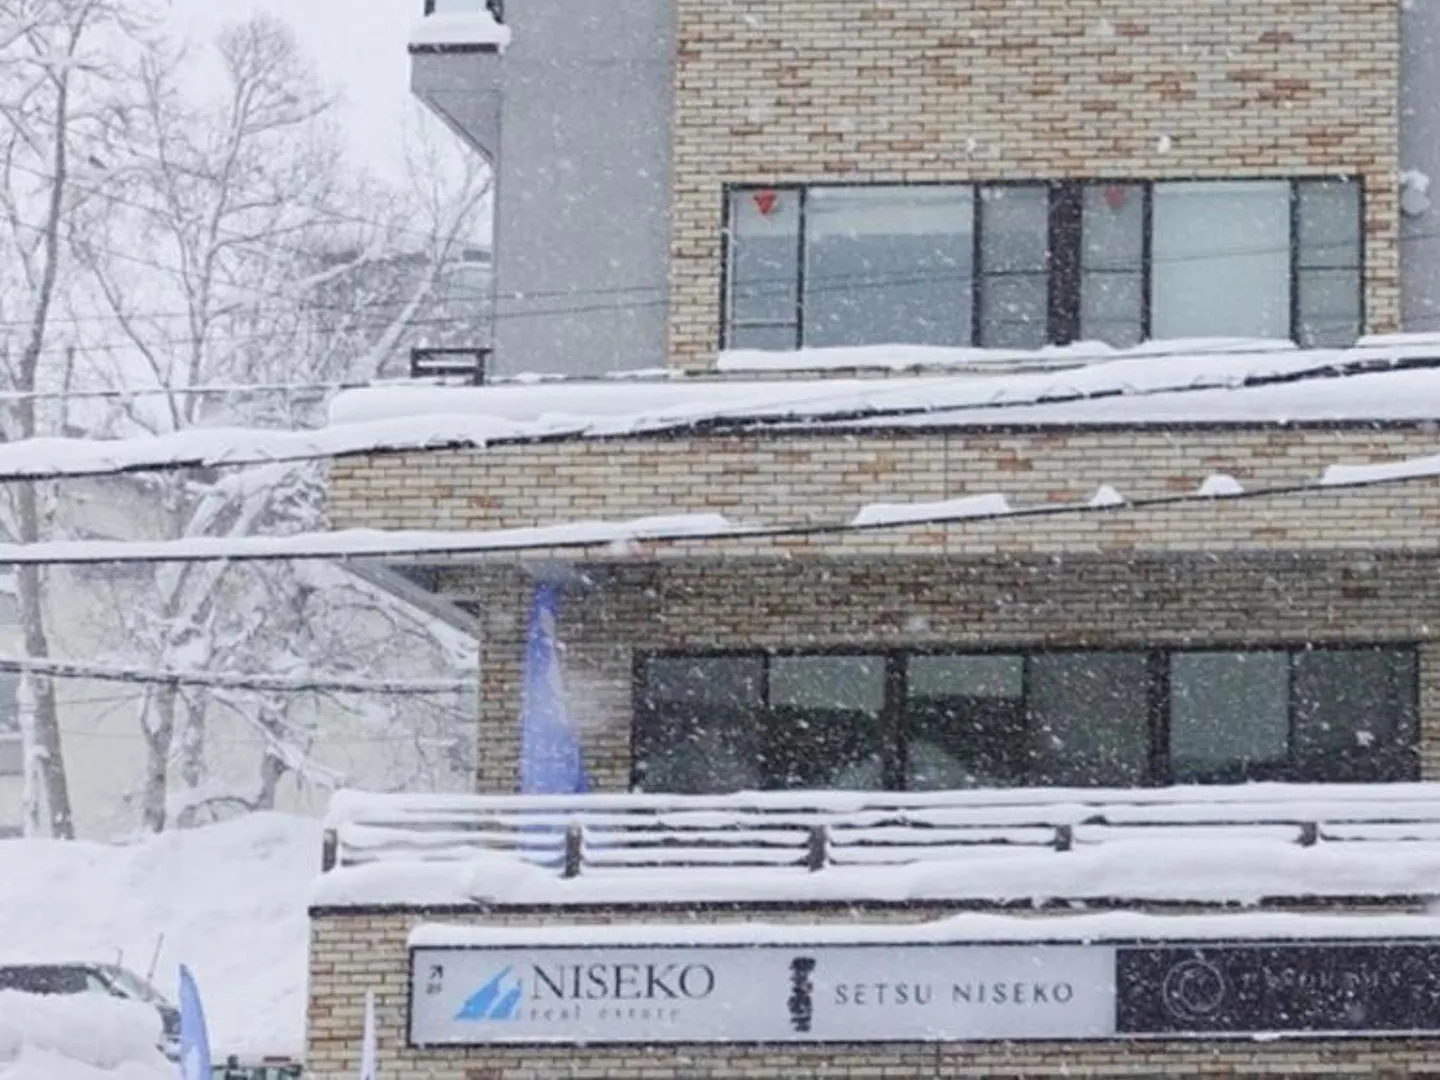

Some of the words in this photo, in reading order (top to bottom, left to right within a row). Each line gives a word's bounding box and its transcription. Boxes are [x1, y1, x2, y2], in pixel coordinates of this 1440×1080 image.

[530, 963, 715, 999] NISEKO
[835, 983, 932, 1005] SETSU
[952, 982, 1074, 1004] NISEKO
[530, 1003, 581, 1020] real
